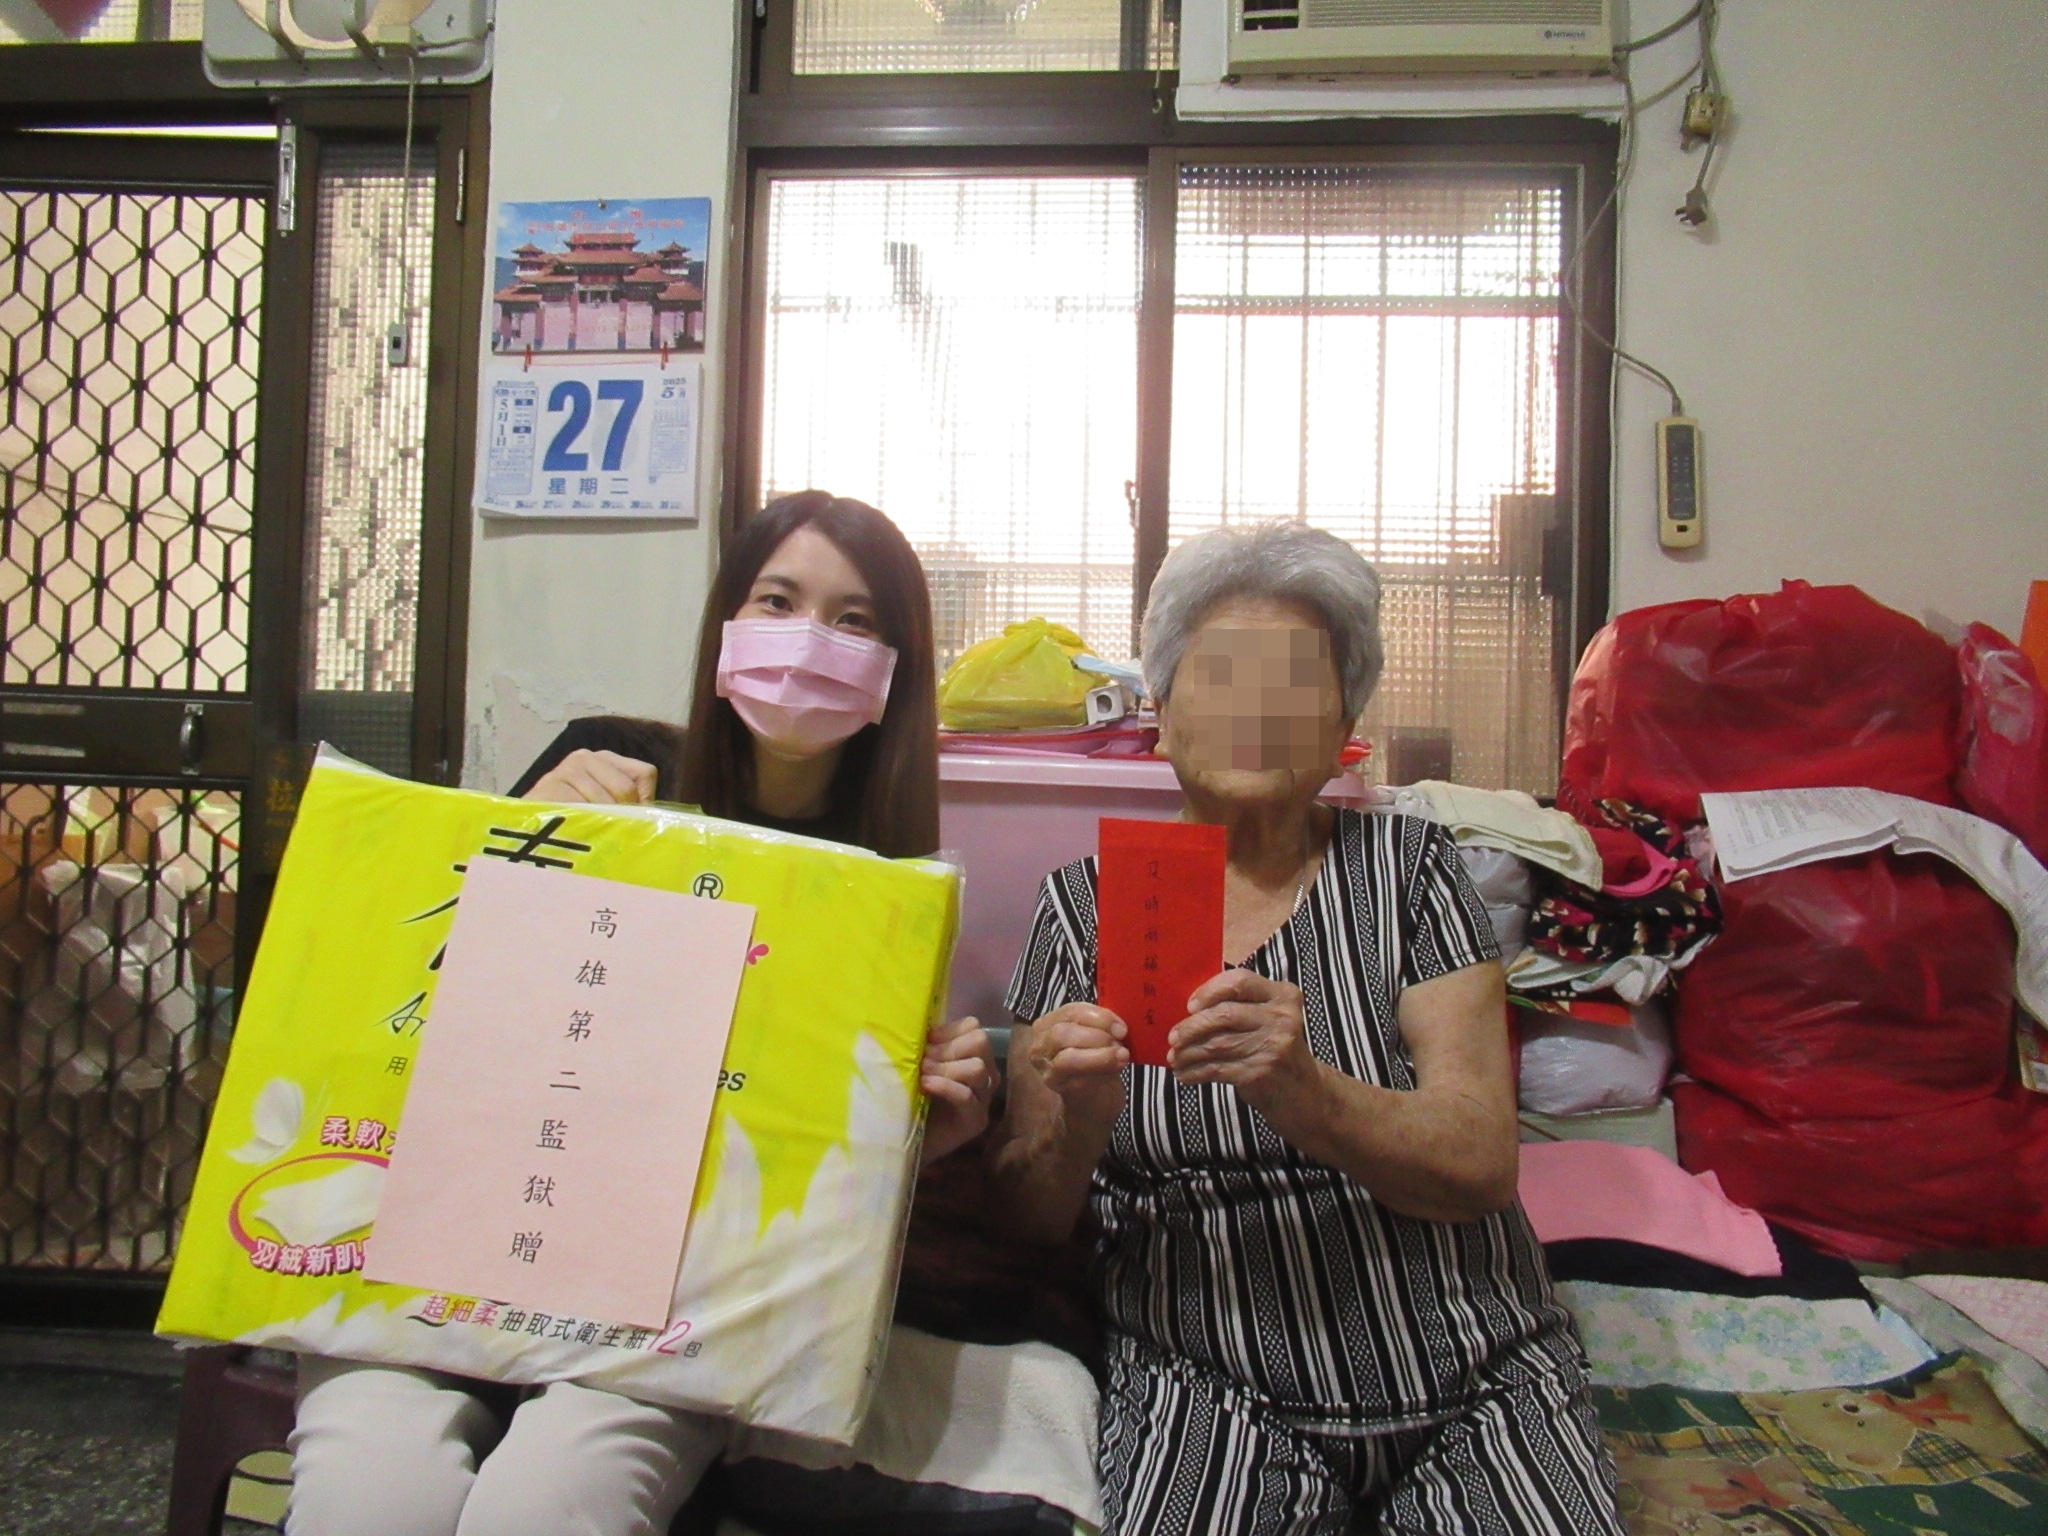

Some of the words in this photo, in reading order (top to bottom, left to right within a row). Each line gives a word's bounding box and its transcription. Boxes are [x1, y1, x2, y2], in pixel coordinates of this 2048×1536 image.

[542, 379, 644, 471] 27
[547, 477, 630, 495] 星期二
[508, 907, 618, 1264] 高雄第二監獄贈
